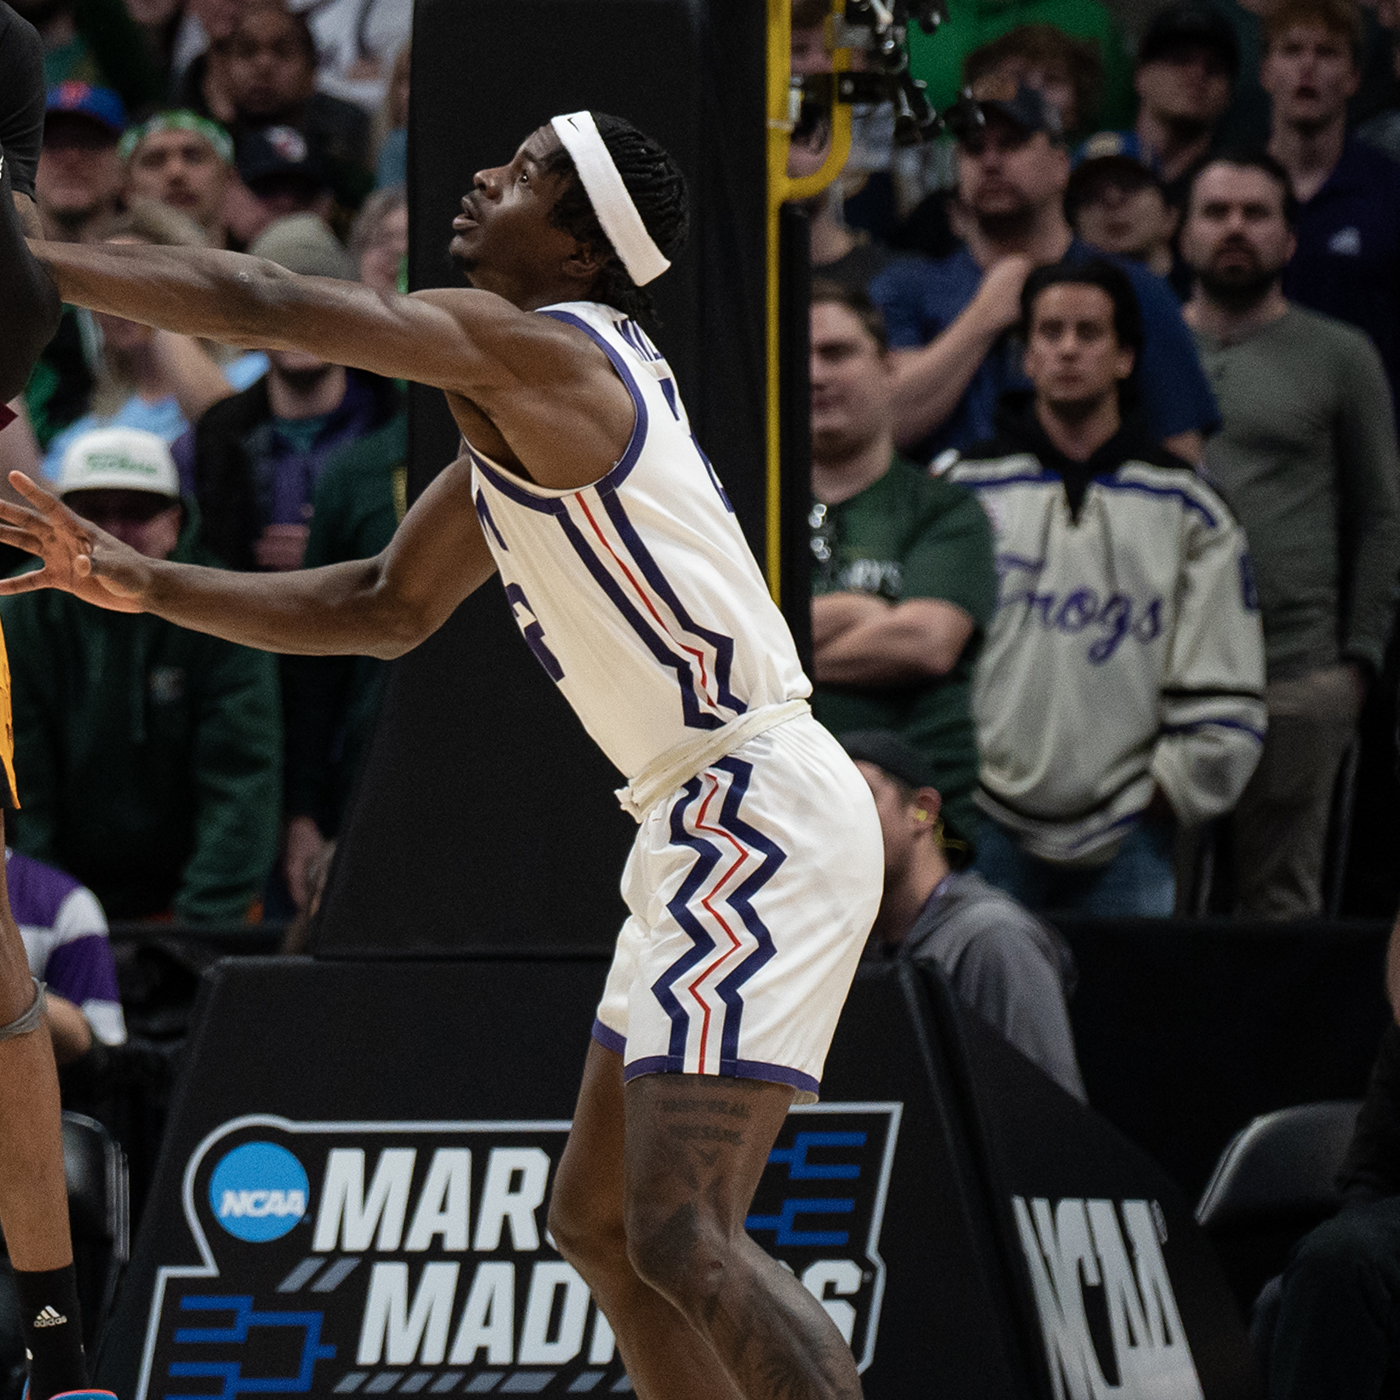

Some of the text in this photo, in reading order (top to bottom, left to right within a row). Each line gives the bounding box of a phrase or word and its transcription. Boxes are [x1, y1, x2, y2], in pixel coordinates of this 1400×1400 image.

[219, 1188, 306, 1217] NCAA
[311, 1147, 558, 1253] MAR
[1011, 1195, 1205, 1400] NCAA
